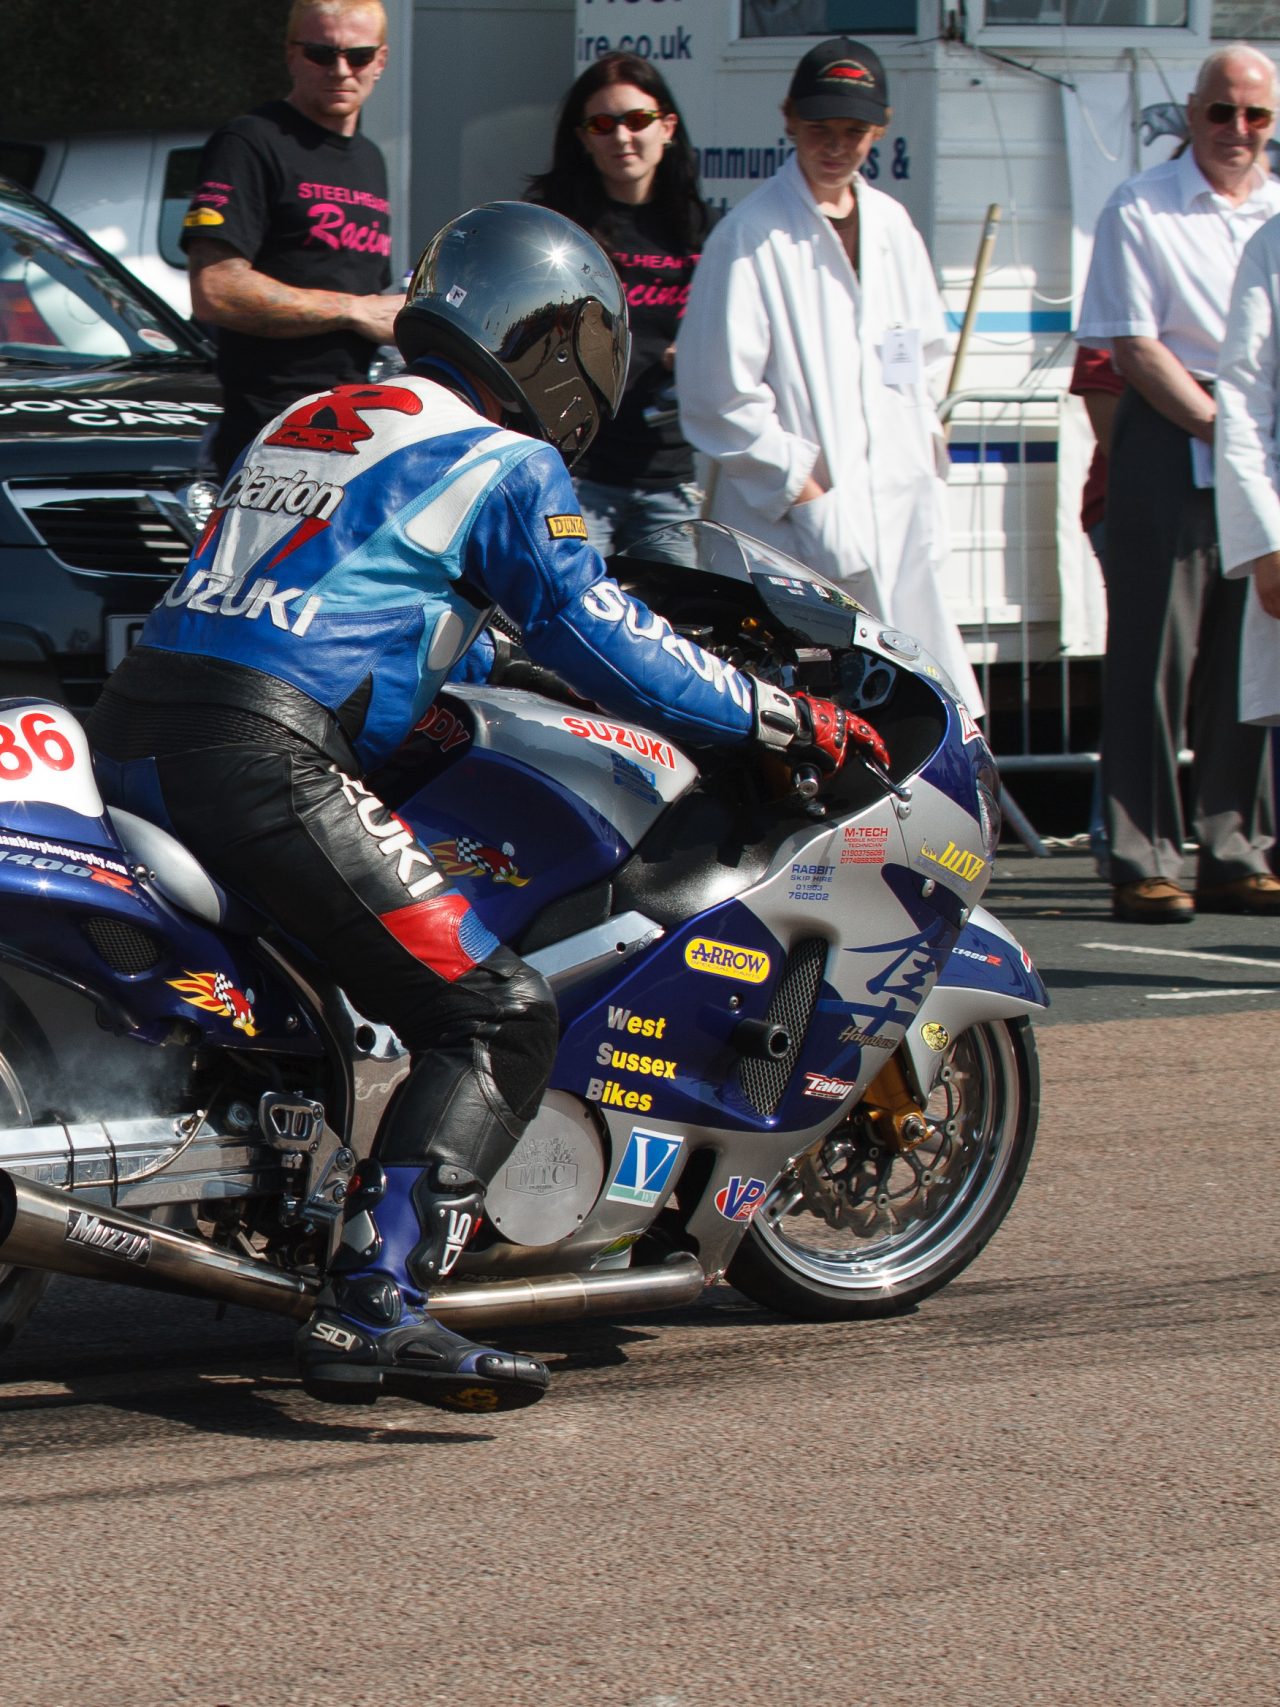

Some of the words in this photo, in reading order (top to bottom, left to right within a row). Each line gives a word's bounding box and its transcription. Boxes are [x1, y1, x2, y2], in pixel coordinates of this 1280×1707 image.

[891, 136, 910, 180] &
[68, 411, 209, 427] CAR
[216, 465, 345, 521] Clarion
[154, 569, 322, 638] UZUKI
[562, 715, 677, 771] SUZUKI
[844, 827, 888, 838] M-TECH
[792, 864, 836, 876] RABBIT
[788, 891, 830, 901] 760202
[691, 943, 766, 974] ARROW
[608, 1005, 667, 1040] West
[596, 1042, 677, 1080] Sussex
[586, 1077, 653, 1112] Bikes
[723, 1175, 767, 1220] VP
